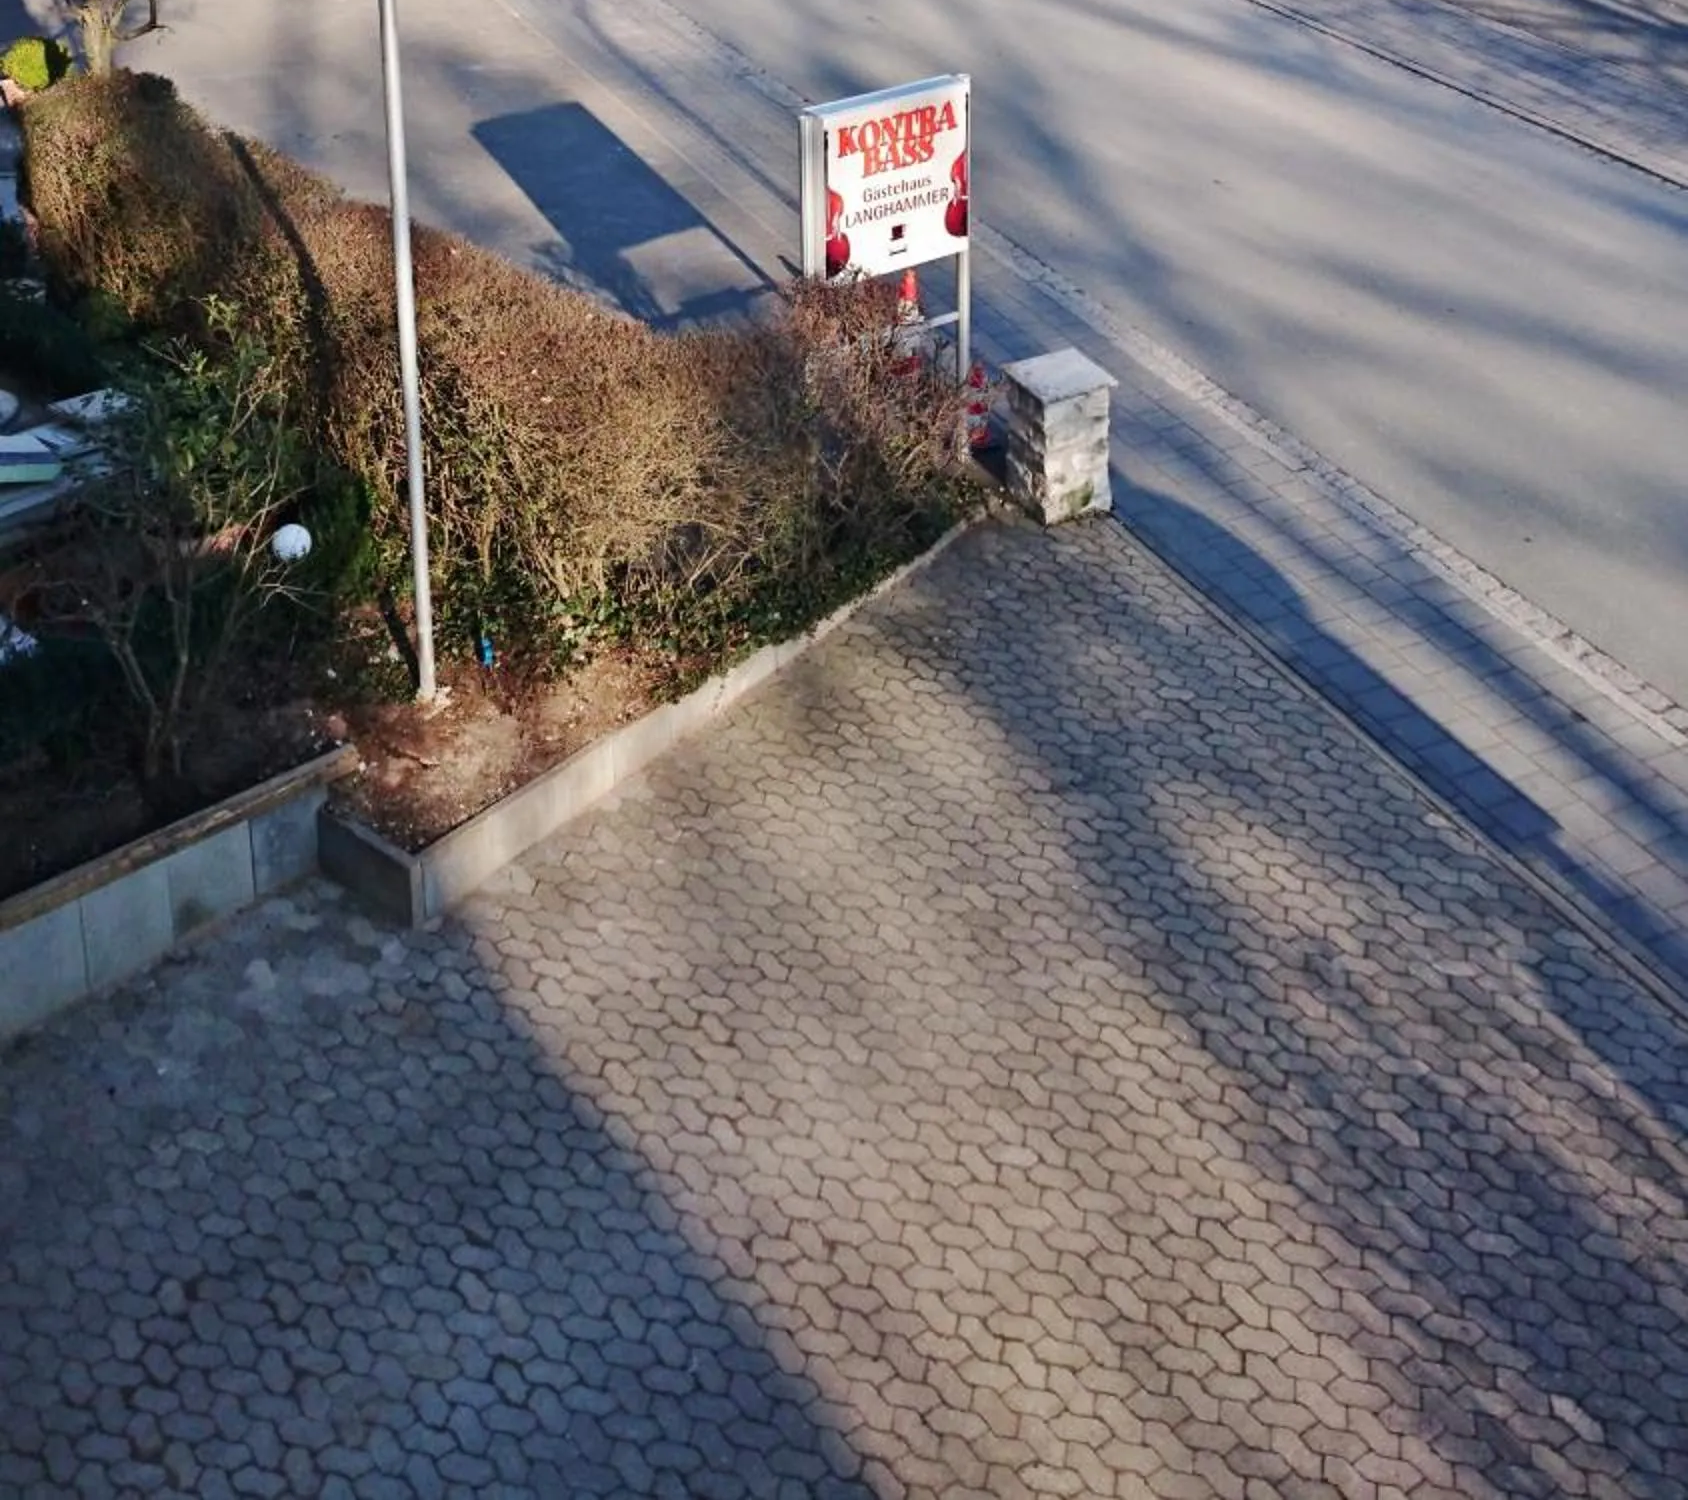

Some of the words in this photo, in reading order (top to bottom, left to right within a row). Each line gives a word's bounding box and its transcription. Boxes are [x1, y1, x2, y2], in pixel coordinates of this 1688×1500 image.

[838, 100, 958, 157] KONTRA
[862, 136, 935, 178] BASS
[845, 187, 949, 229] LANGHAMMER
